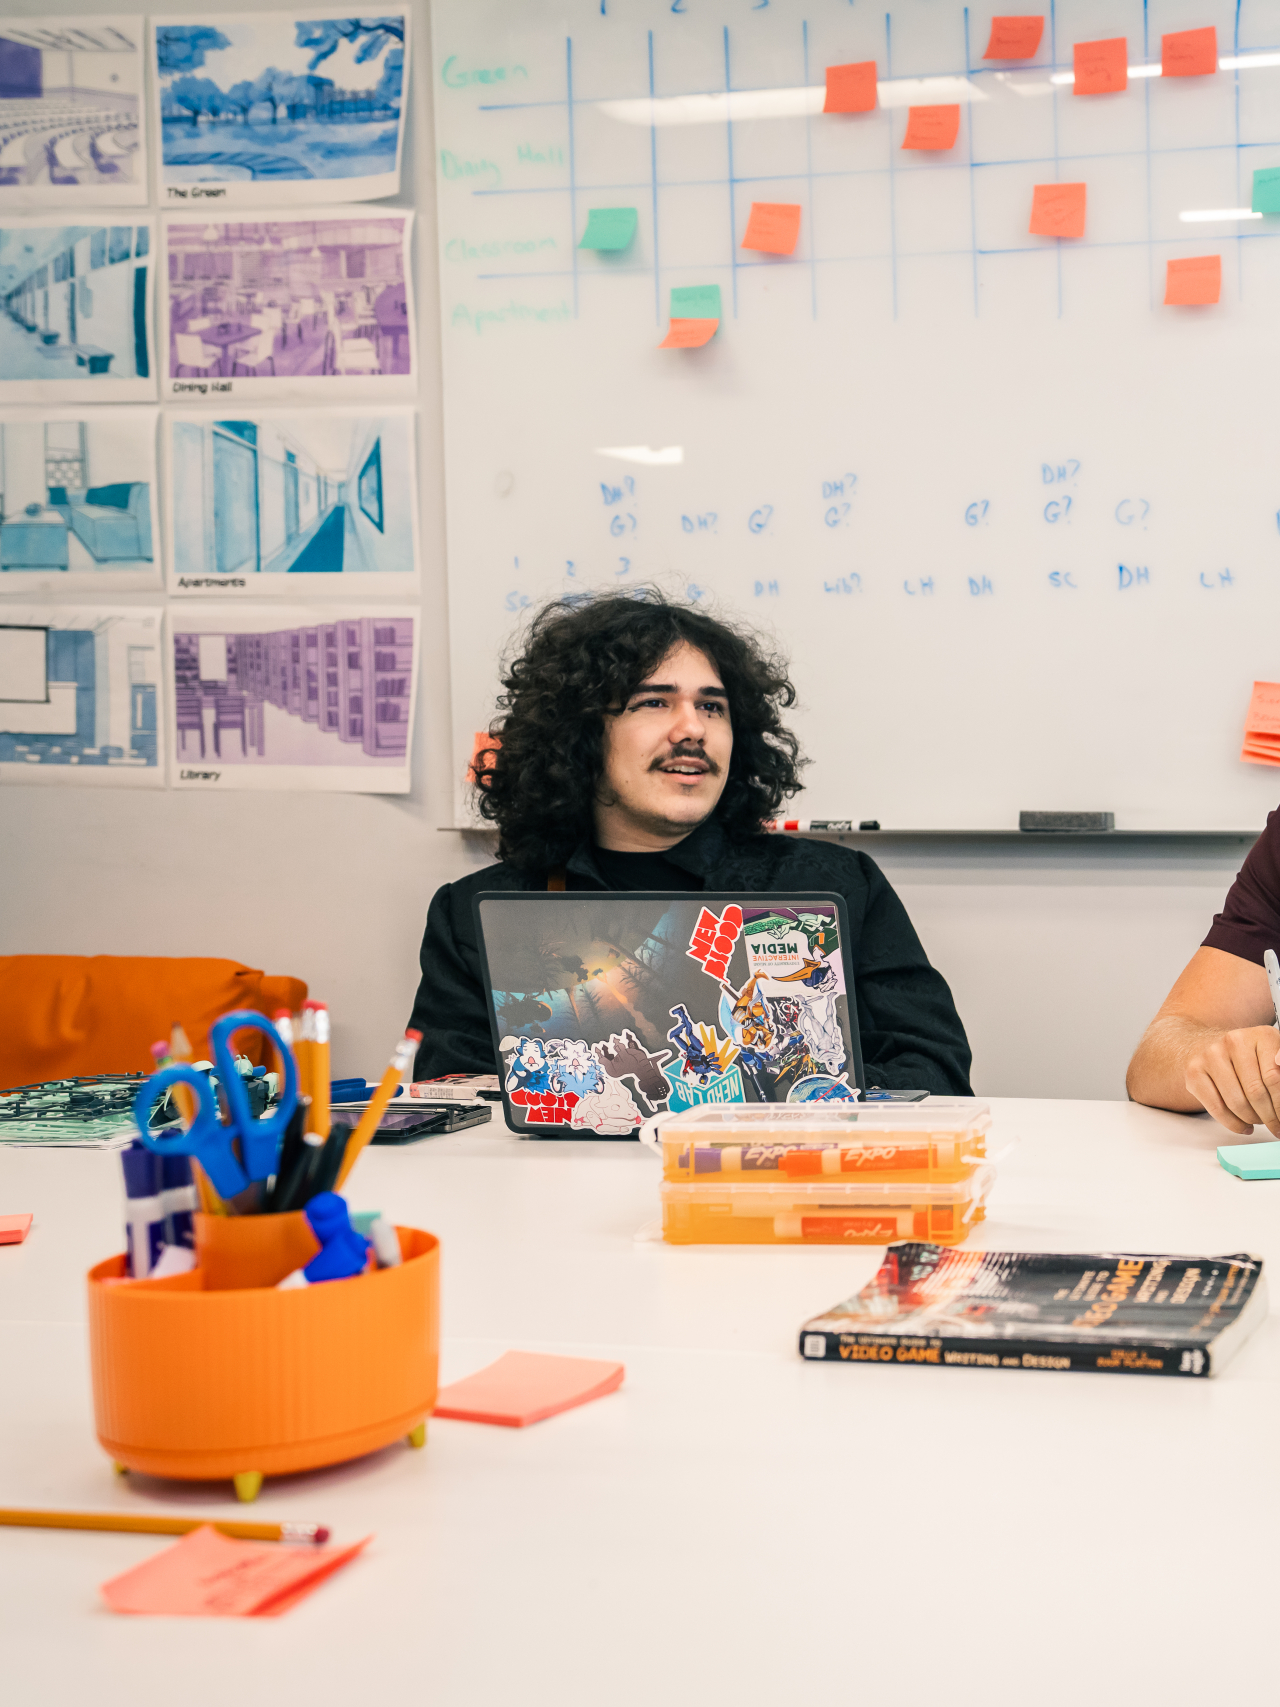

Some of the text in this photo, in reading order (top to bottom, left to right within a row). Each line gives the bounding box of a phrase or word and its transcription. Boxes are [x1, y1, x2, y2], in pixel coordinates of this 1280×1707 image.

[440, 55, 528, 89] Green
[167, 187, 188, 199] The
[444, 237, 558, 263] Classroom
[1118, 563, 1151, 591] DH
[180, 769, 221, 782] Library
[688, 907, 721, 963] NEW
[751, 942, 798, 955] MEDIA
[752, 954, 800, 962] INTERACTIVE
[675, 1073, 740, 1106] NERD LAB
[527, 1106, 572, 1124] NEW
[844, 1146, 897, 1167] EXPO
[1101, 1259, 1145, 1303] GAME
[838, 1344, 893, 1361] VIDEO
[896, 1346, 942, 1364] GAME
[1022, 1353, 1072, 1371] DESIGN
